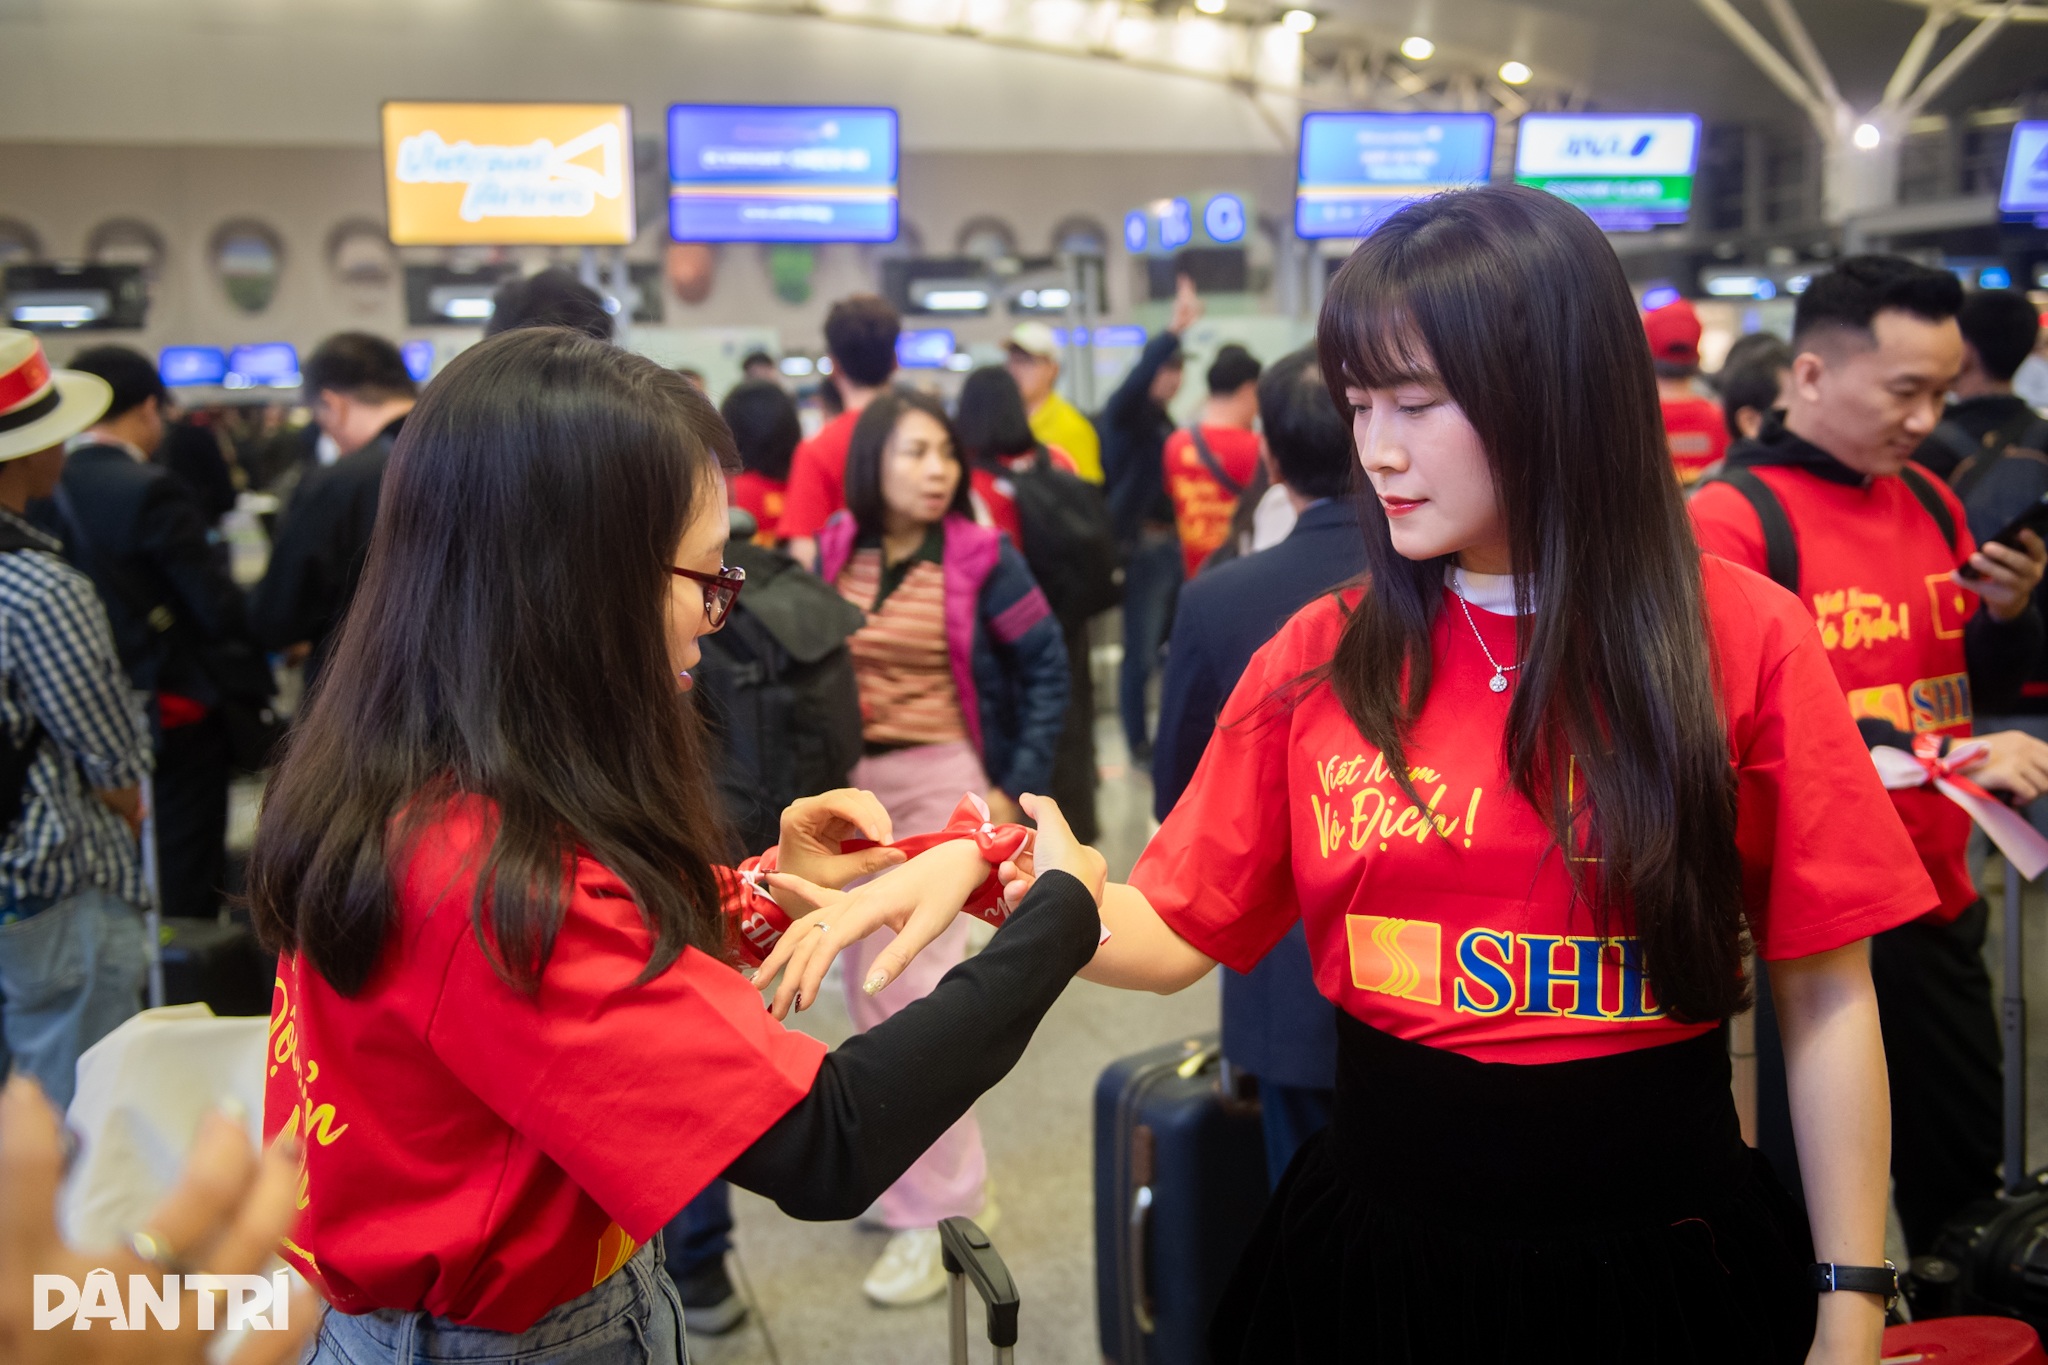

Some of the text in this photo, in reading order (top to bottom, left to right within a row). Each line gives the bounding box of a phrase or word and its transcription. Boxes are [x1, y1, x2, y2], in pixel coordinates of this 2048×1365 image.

[1908, 672, 1972, 732] SH
[1317, 751, 1441, 796] Việt Nm
[1311, 794, 1346, 859] Vô
